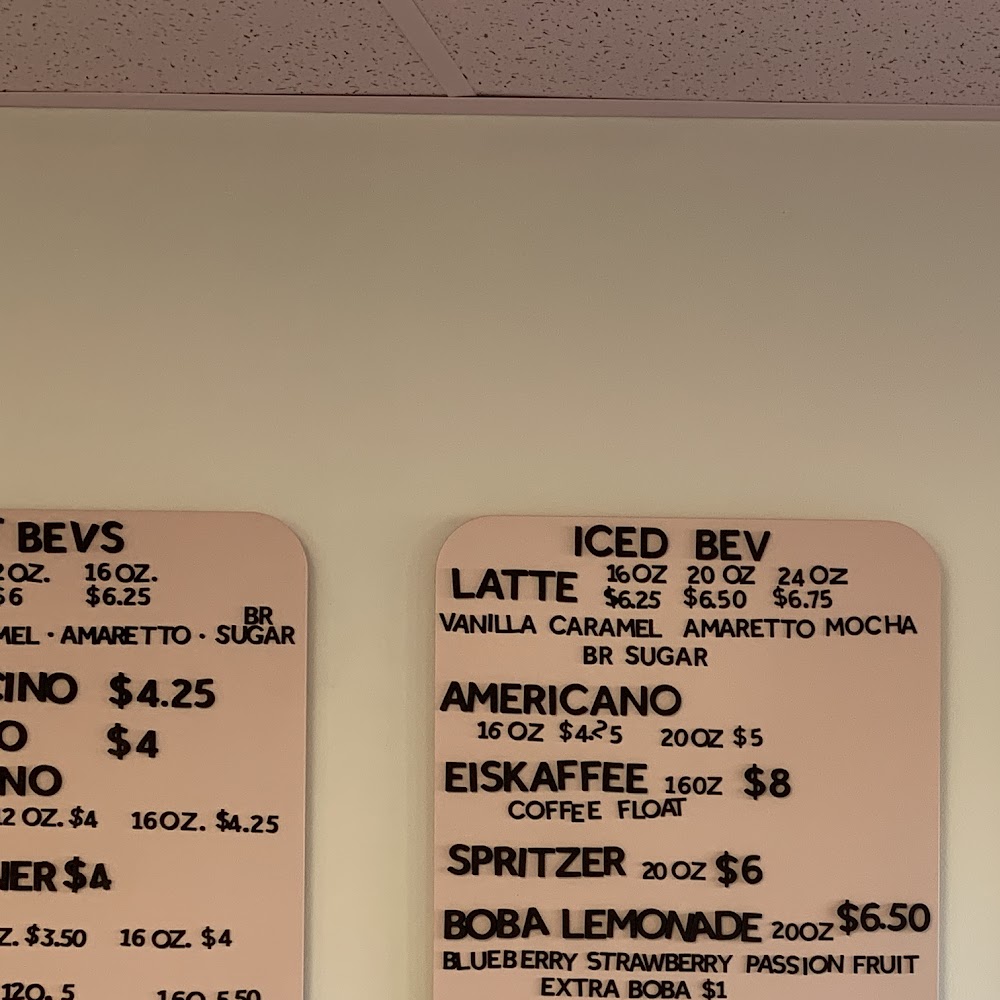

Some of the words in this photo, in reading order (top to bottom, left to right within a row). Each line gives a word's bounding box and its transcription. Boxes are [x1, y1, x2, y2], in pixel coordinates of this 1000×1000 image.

[17, 520, 125, 554] BEVS
[574, 524, 669, 560] ICED
[695, 528, 771, 562] BEV
[85, 581, 151, 608] $6.25
[451, 567, 578, 604] LATTE
[603, 585, 662, 610] $6.25
[683, 581, 747, 610] $6.50
[772, 583, 833, 609] $6.75
[243, 605, 273, 622] BR
[438, 612, 538, 635] VANILLA
[548, 614, 663, 639] CARAMEL
[682, 618, 816, 639] AMARETTO
[825, 614, 918, 637] MOCHA
[59, 625, 192, 646] AMARETTO
[214, 625, 296, 645] SUGAR
[583, 645, 614, 666] BR
[624, 645, 709, 667] SUGAR
[108, 671, 216, 710] $4.25
[439, 680, 683, 717] AMERICANO
[106, 722, 160, 761] $4
[732, 724, 764, 749] $5
[444, 759, 649, 795] EISKAFFEE
[743, 763, 792, 801] $8
[68, 805, 99, 829] $4
[215, 808, 280, 834] $4.25
[507, 799, 603, 823] COFFEE
[617, 797, 688, 820] FLOAT
[62, 855, 113, 894] $4
[446, 843, 627, 878] SPRITZER
[715, 850, 764, 889] $6
[443, 906, 551, 941] BOBA
[561, 907, 763, 943] LEMONADE
[836, 899, 931, 937] $6.50
[24, 923, 87, 948] $3.50
[201, 925, 233, 950] $4
[442, 949, 579, 972] BLUEBERRY
[586, 951, 734, 974] STRAWBERRY
[745, 954, 845, 976] PASSION
[853, 954, 920, 975] FRUIT
[540, 977, 621, 999] EXTRA
[628, 979, 692, 1000] BOBA
